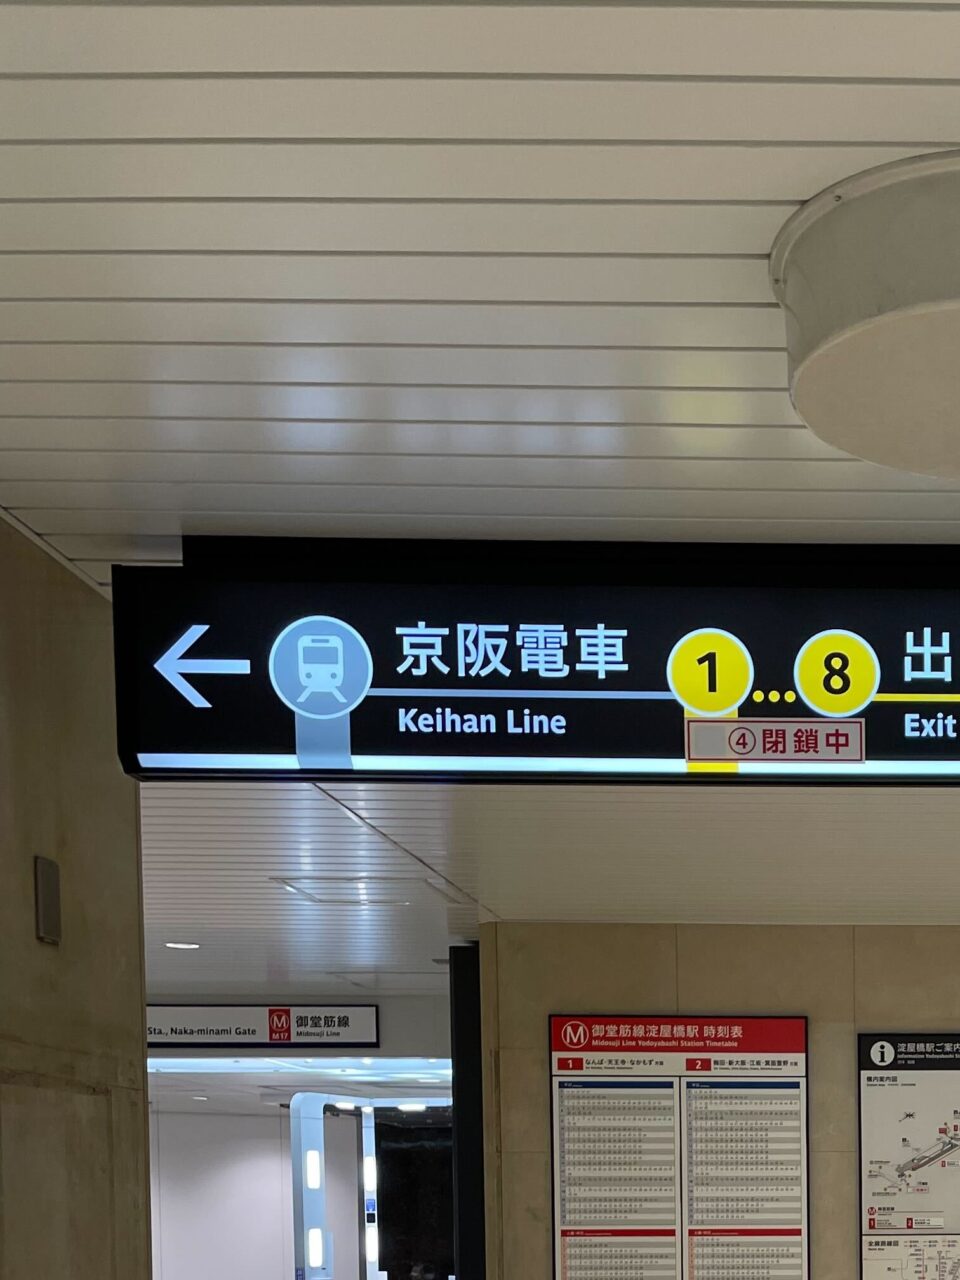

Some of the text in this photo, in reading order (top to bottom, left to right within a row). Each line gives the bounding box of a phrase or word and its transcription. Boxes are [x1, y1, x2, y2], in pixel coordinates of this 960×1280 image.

[395, 622, 630, 681] 京阪電車
[696, 653, 720, 694] 1
[822, 652, 852, 695] 8
[399, 708, 567, 735] Keihan Line
[904, 713, 957, 739] Exit
[170, 1026, 232, 1036] Naka-minami
[235, 1026, 257, 1036] Gate
[296, 1015, 350, 1028] 御堂筋線
[591, 1024, 743, 1038] 御堂筋線淀屋橋駅 時刻表
[296, 1030, 341, 1039] Midosuji Line
[591, 1040, 620, 1048] Midosuji
[638, 1040, 679, 1048] Yodoyabashi
[706, 1040, 738, 1048] Timetable
